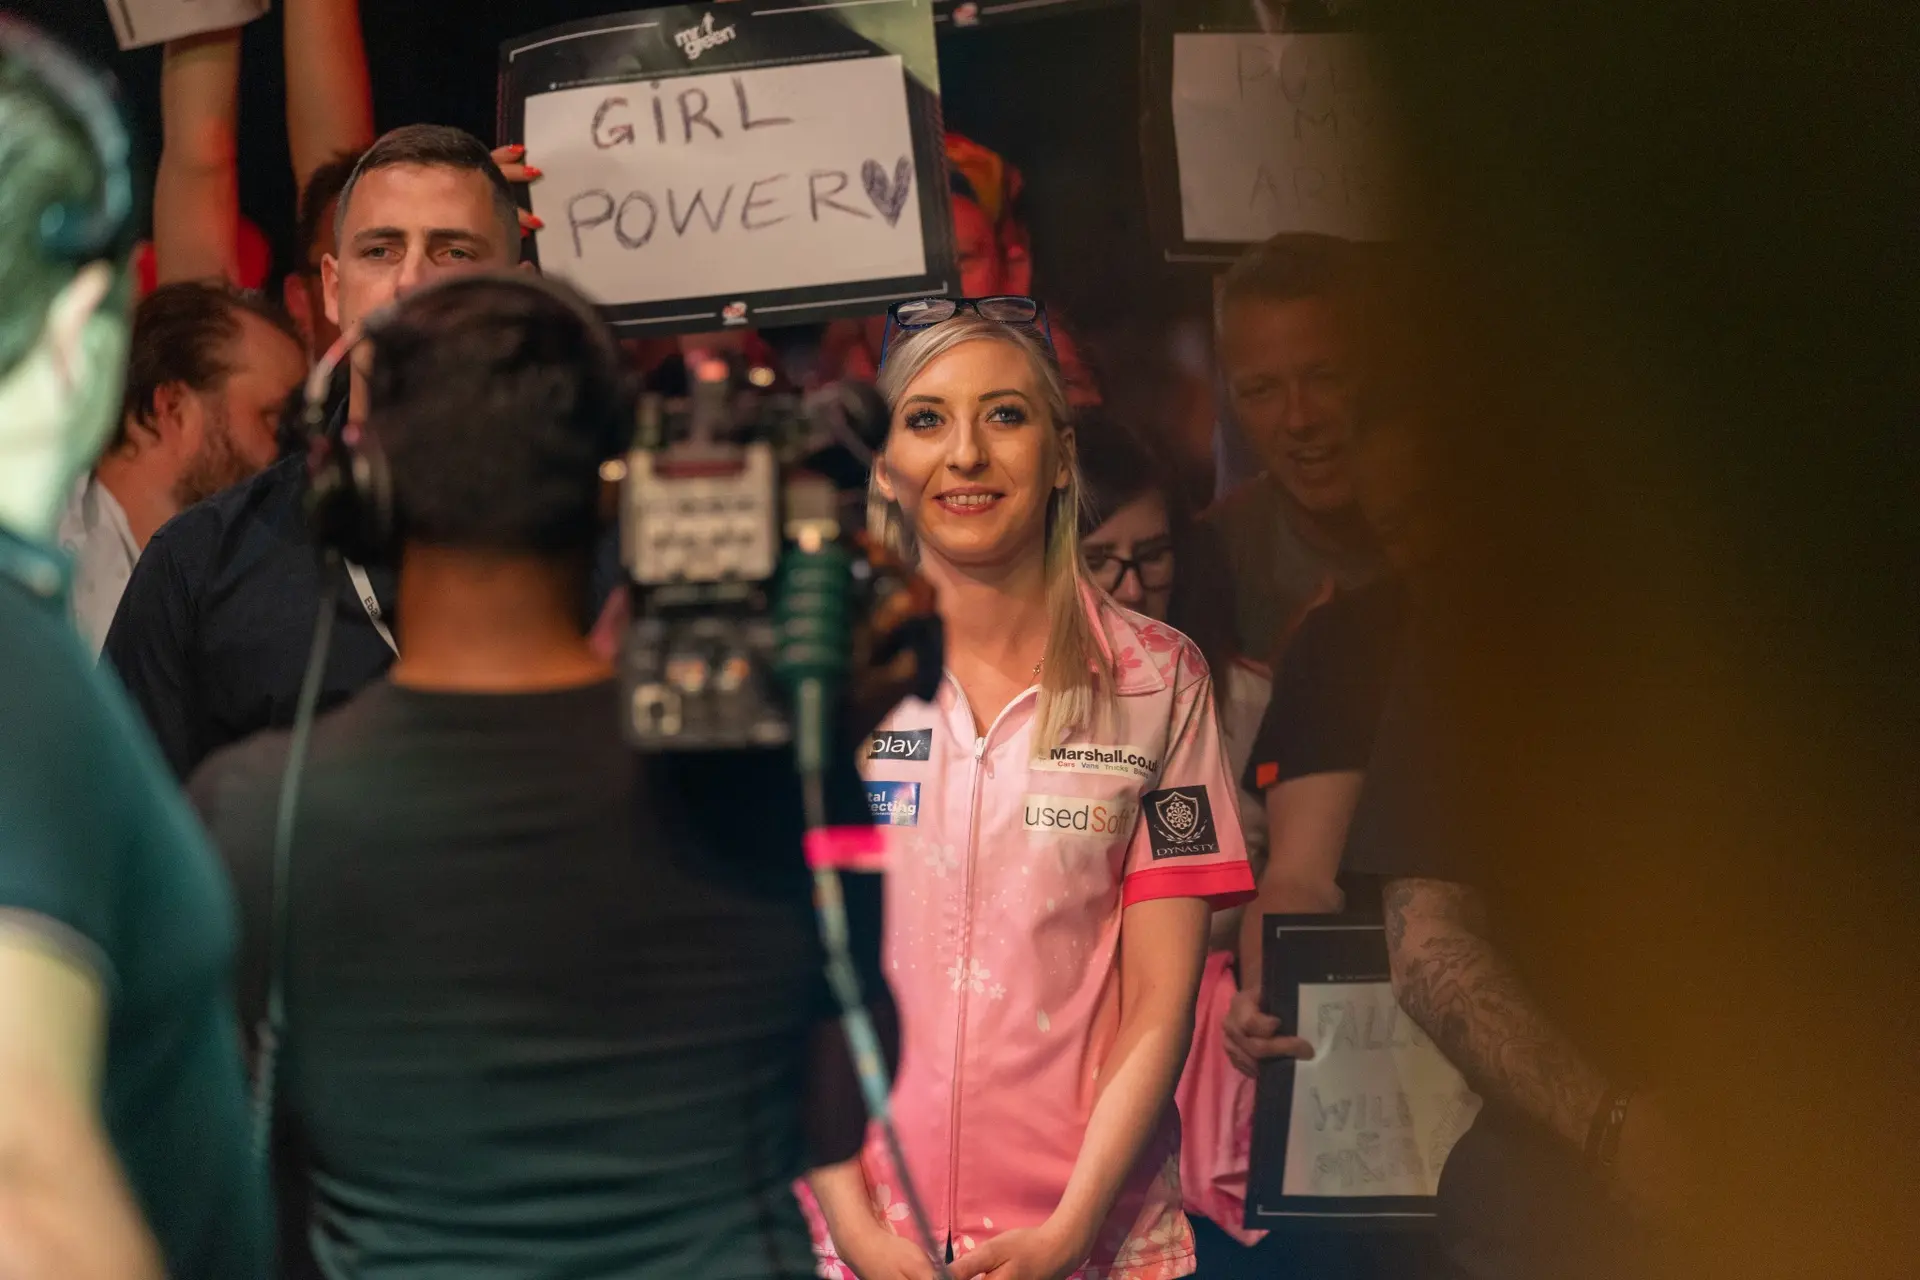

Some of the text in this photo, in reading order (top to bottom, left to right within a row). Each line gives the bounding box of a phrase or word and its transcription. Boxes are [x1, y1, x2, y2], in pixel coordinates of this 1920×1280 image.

[566, 169, 873, 258] POWER
[1081, 762, 1099, 770] Vans
[1104, 764, 1129, 773] Trucks
[867, 791, 886, 802] tal
[868, 801, 917, 815] ecting
[1156, 843, 1214, 857] DYNASTY
